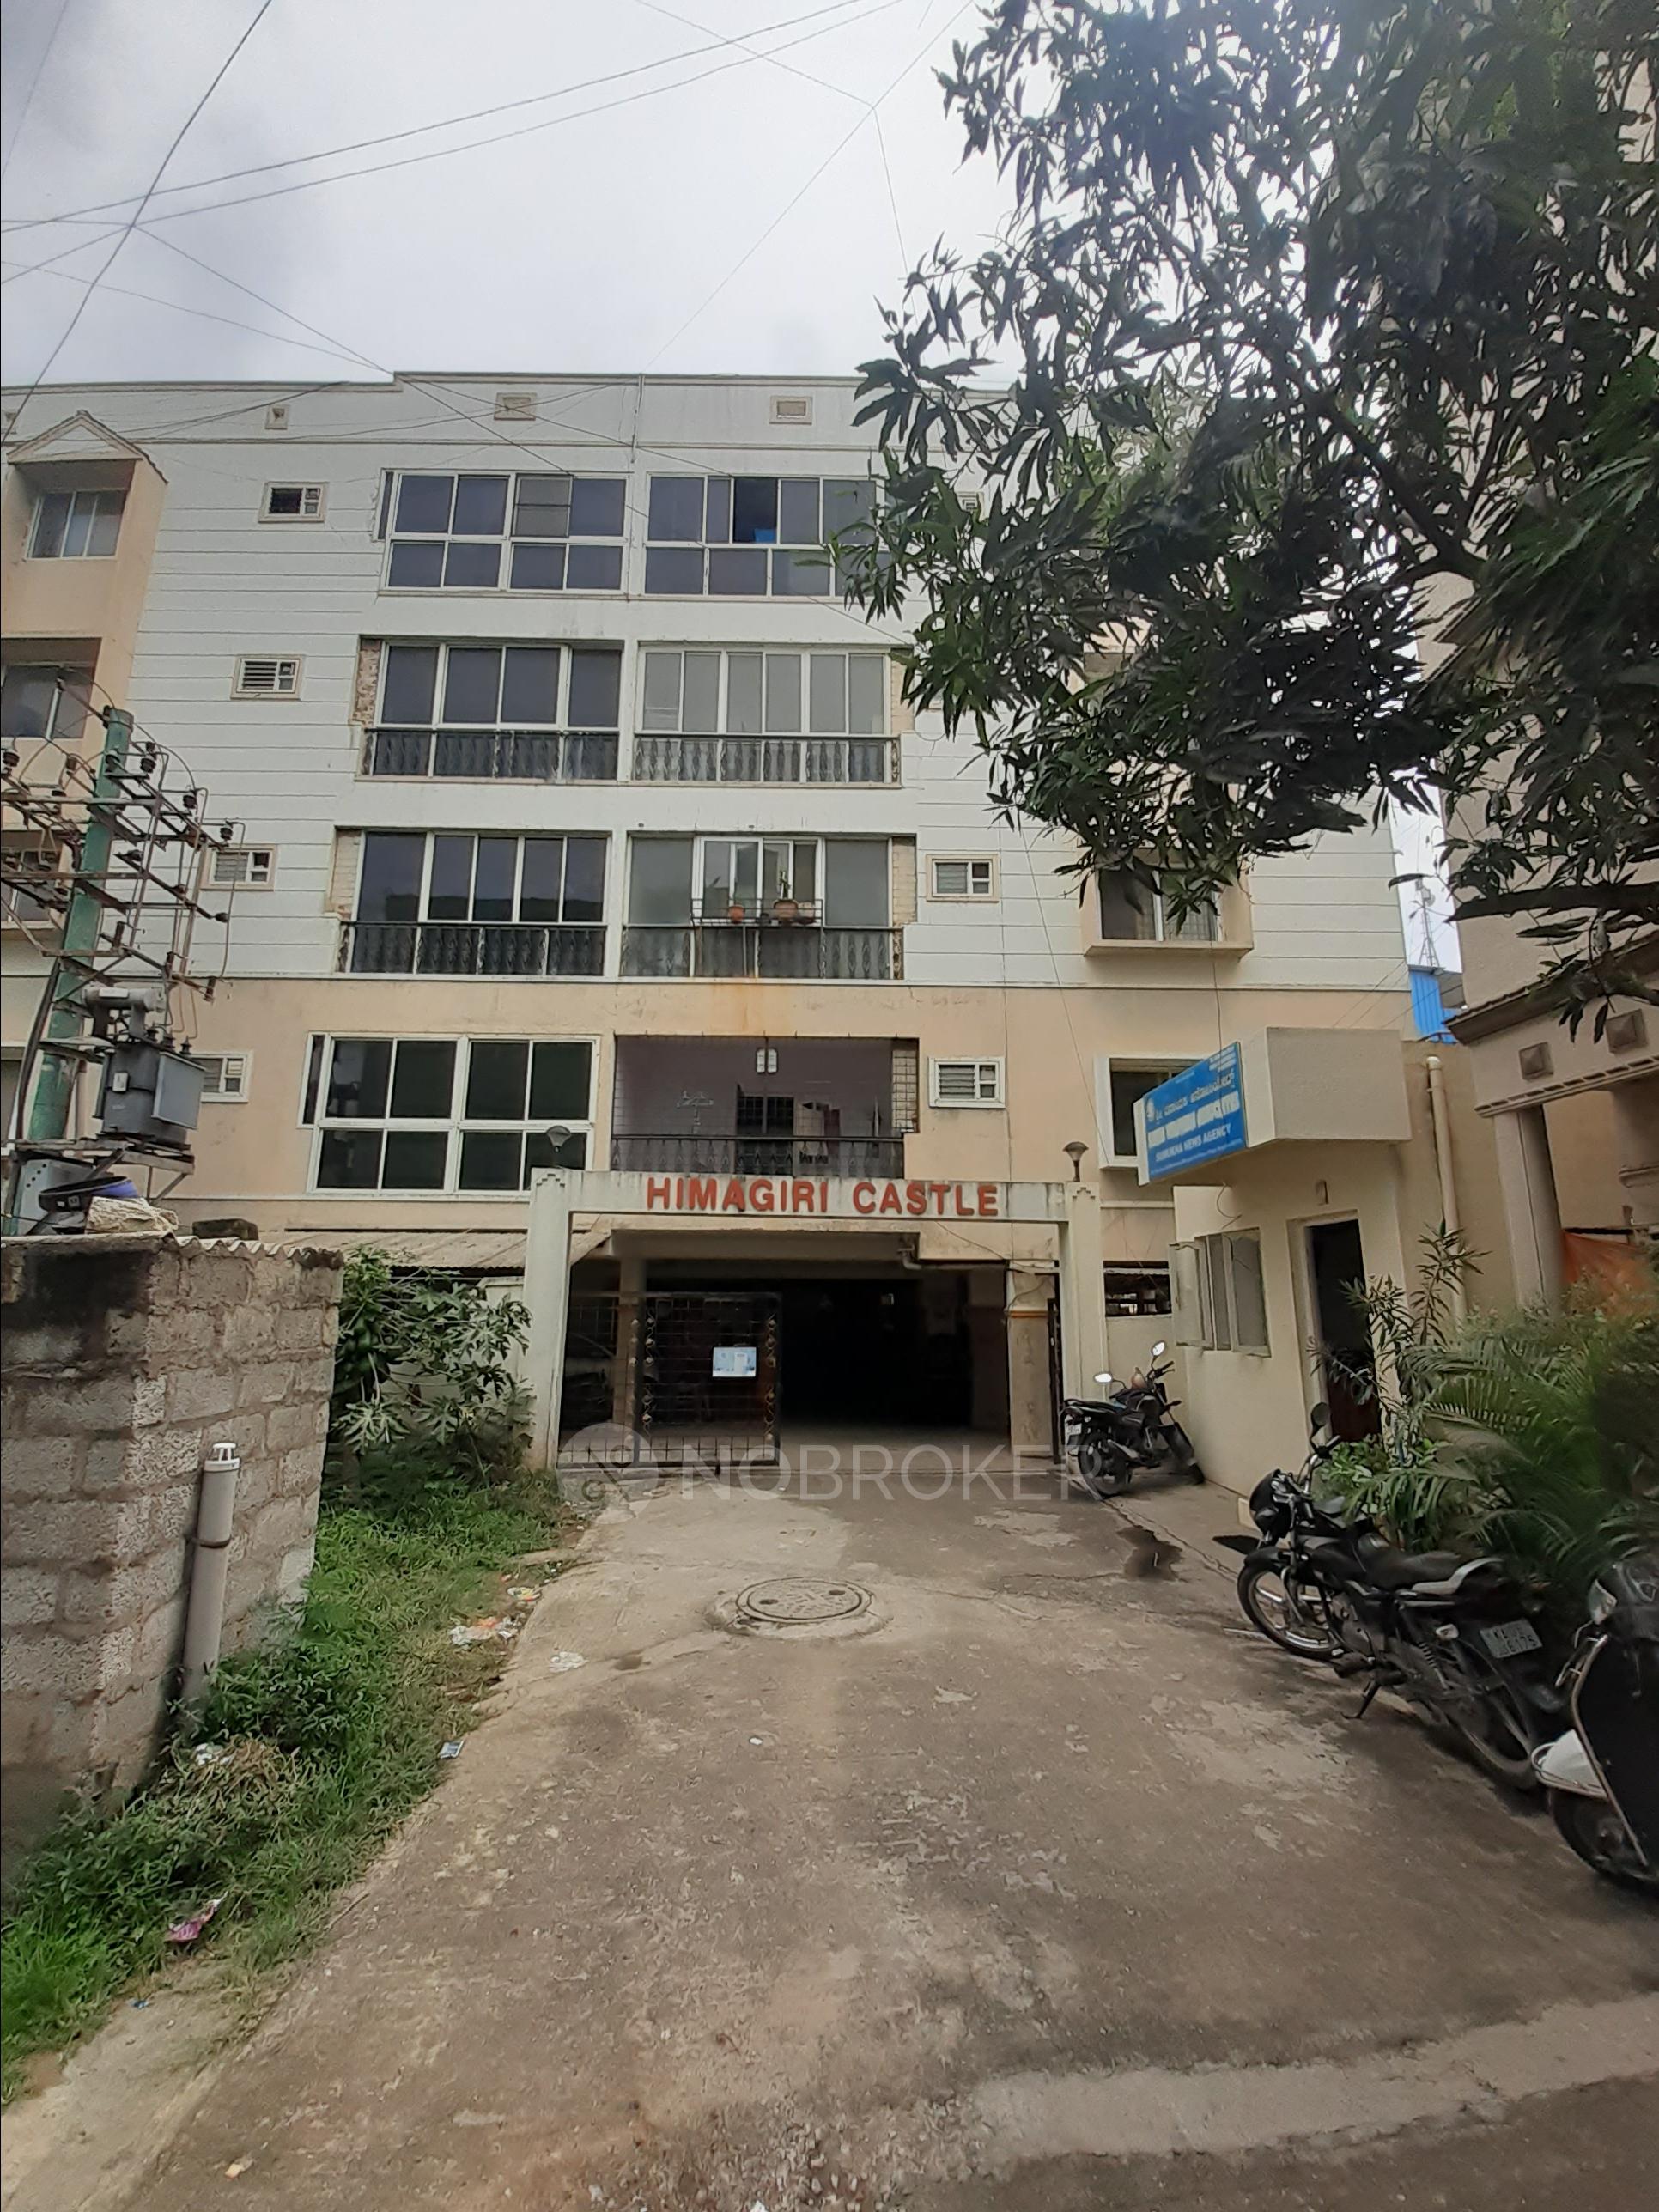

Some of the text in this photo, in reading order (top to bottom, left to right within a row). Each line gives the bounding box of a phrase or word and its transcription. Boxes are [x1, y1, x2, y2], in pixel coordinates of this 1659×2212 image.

[1183, 1135, 1202, 1151] NEWS
[1203, 1123, 1231, 1143] AGENCY
[647, 1177, 999, 1217] HIMAGIRI CASTLE
